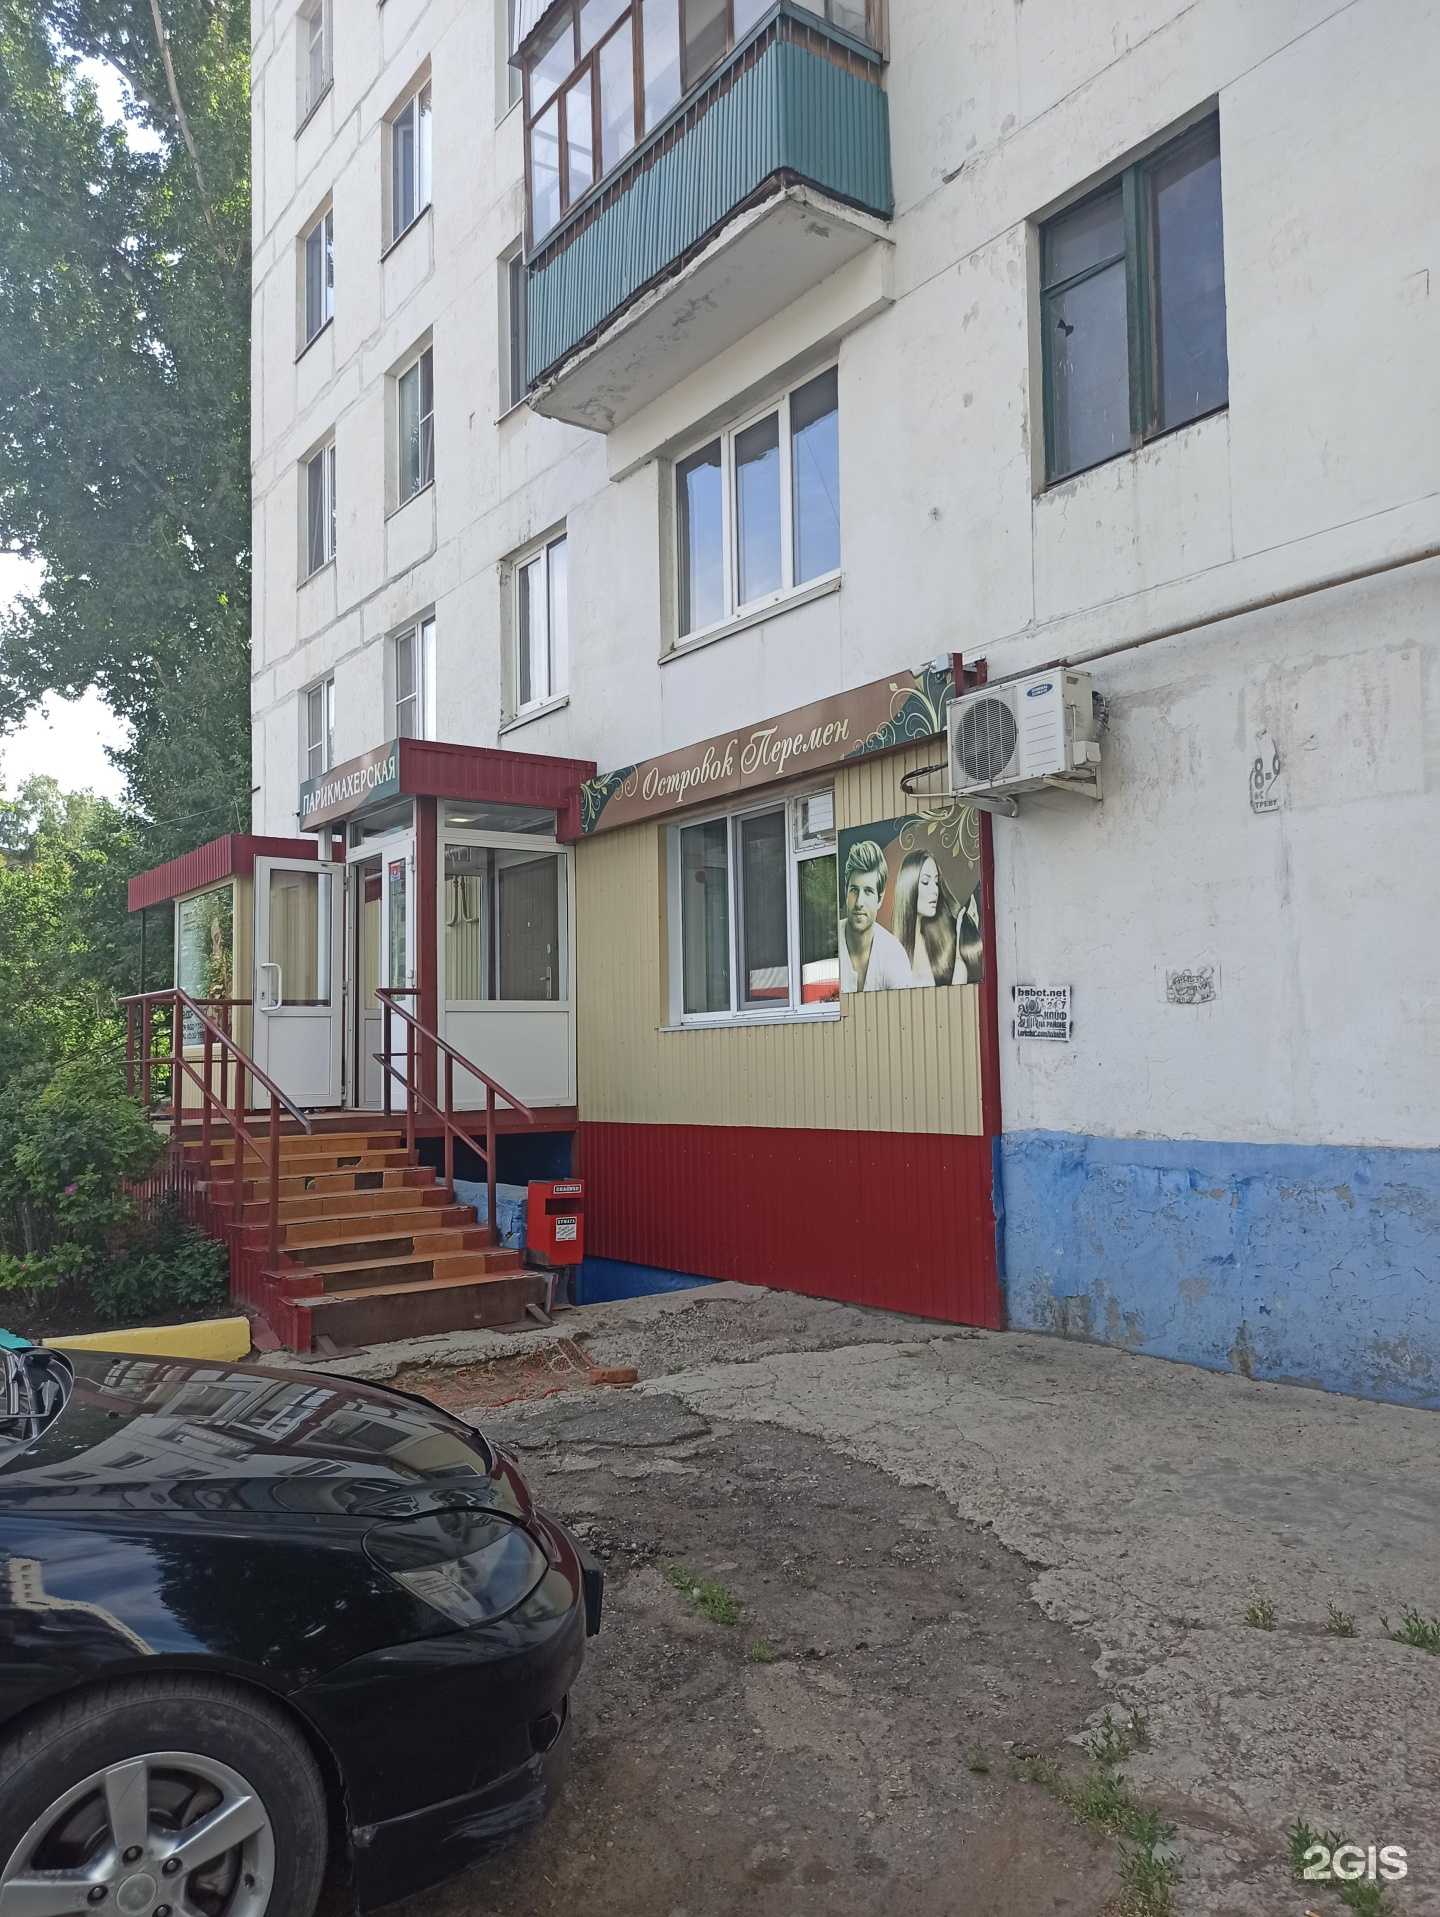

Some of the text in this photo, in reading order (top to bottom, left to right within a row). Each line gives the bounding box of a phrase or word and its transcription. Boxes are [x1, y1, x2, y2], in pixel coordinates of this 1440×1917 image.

[302, 756, 396, 816] ПАРИКМАХЕРСКАЯ
[643, 719, 849, 803] Островок Перемен
[1018, 988, 1067, 997] bsbot.net
